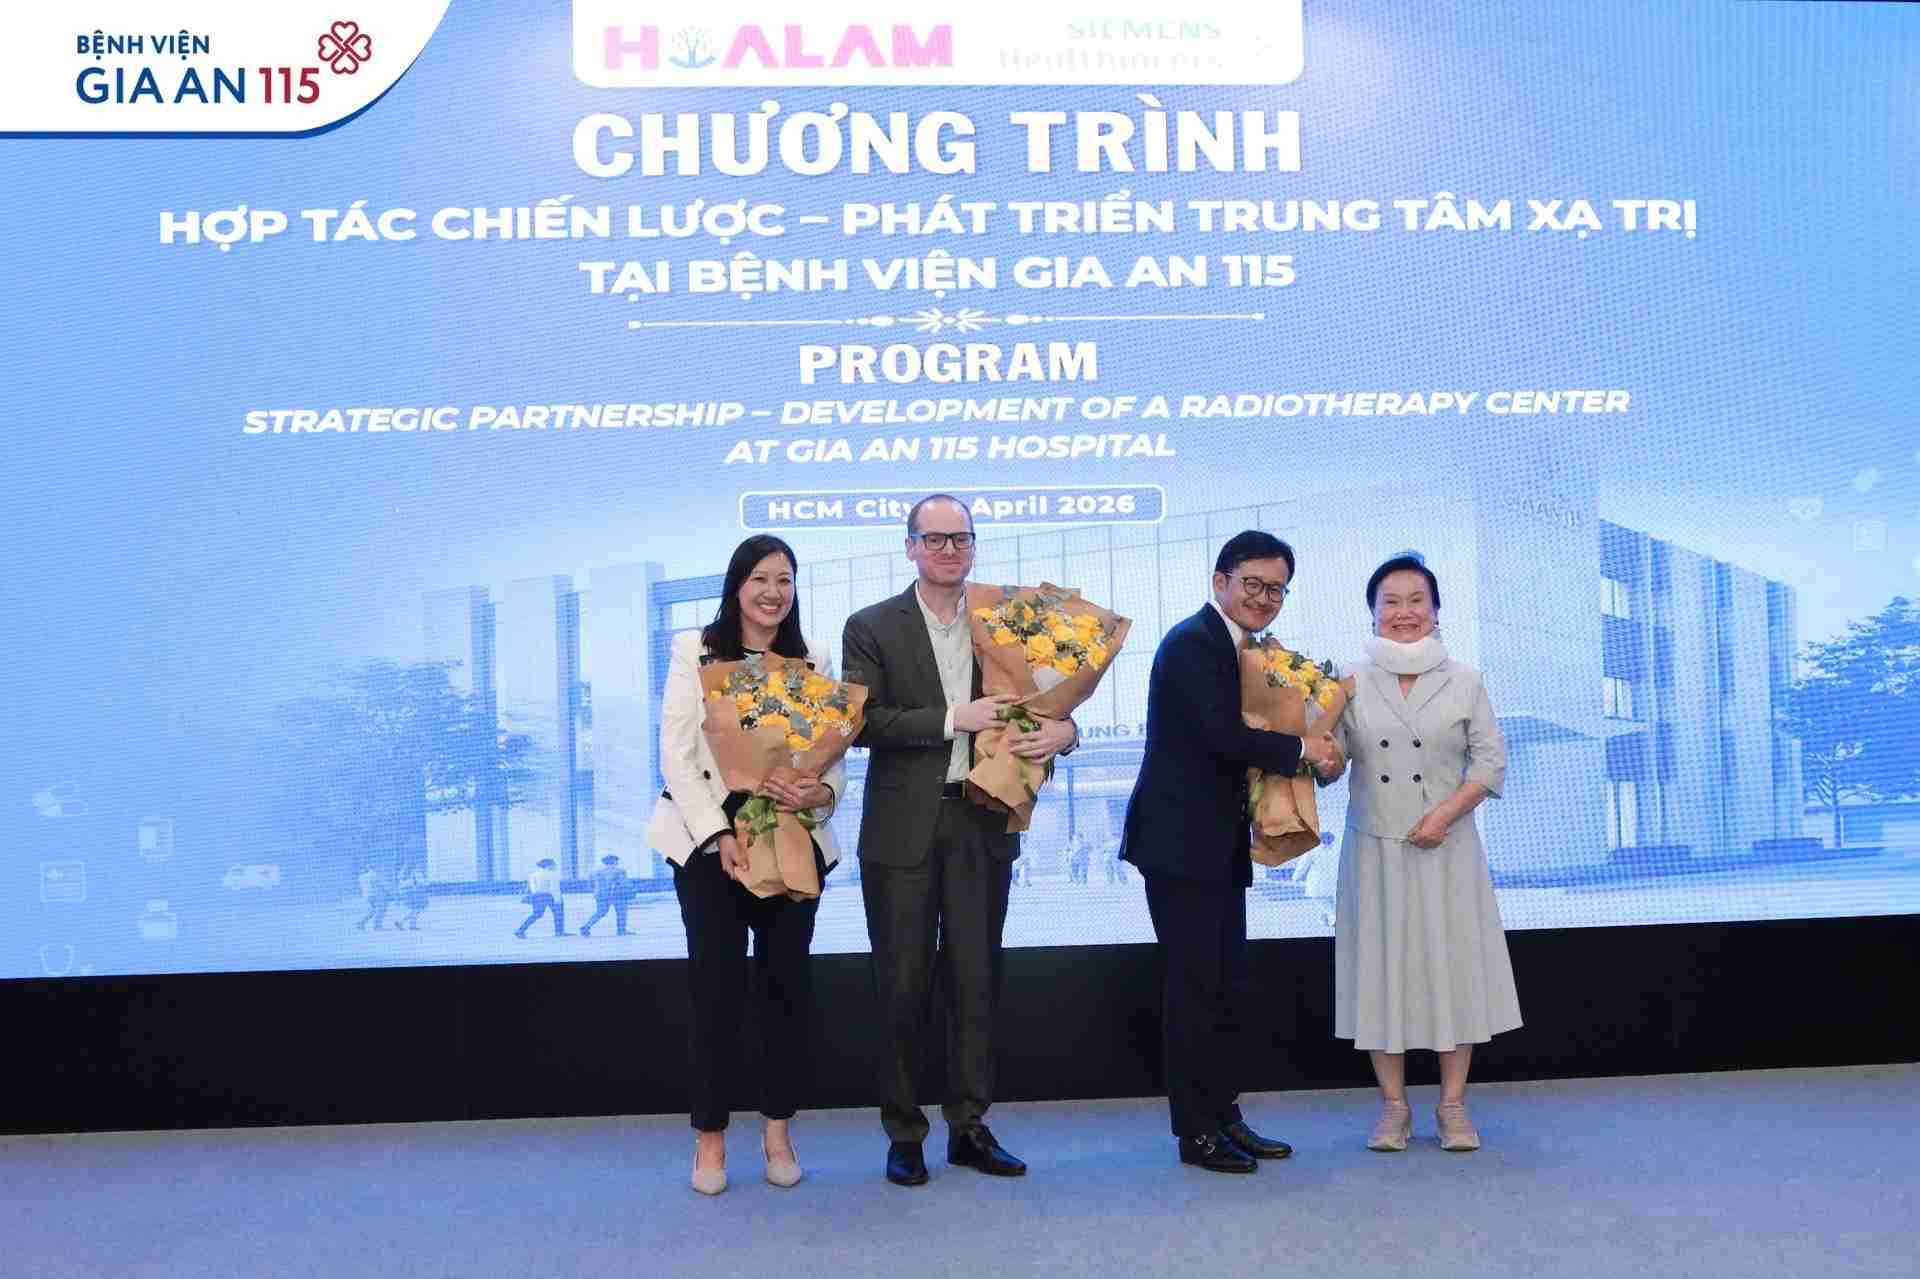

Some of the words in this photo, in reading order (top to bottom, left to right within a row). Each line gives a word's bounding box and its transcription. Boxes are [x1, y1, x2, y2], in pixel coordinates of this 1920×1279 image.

[572, 100, 976, 178] CHƯƠNG
[1010, 94, 1301, 173] TRÌNH
[160, 205, 287, 252] HỢP
[302, 200, 416, 242] TÁC
[432, 195, 610, 241] CHIẾN
[628, 198, 785, 245] LƯỢC
[843, 193, 997, 235] PHÁT
[1008, 190, 1175, 234] TRIỂN
[1188, 199, 1381, 232] TRUNG
[1393, 192, 1512, 231] TÂM
[1528, 200, 1602, 238] XẠ
[1613, 200, 1697, 238] TRỊ
[579, 261, 670, 302] TẠI
[688, 251, 848, 300] BỆNH
[862, 249, 997, 299] VIỆN
[1013, 256, 1113, 289] GIA
[1125, 256, 1206, 288] AN
[1221, 255, 1295, 287] 115
[799, 341, 1098, 385] PROGRAM
[243, 407, 460, 434] STRATEGIC
[469, 402, 744, 431] PARTNERSHIP
[780, 398, 1072, 426] DEVELOPMENT
[1081, 396, 1138, 420] OF
[1142, 397, 1170, 419] A
[1180, 392, 1474, 419] RADIOTHERAPY
[1486, 390, 1630, 415] CENTER
[724, 440, 780, 464] AT
[786, 439, 853, 463] GIA
[860, 438, 920, 462] AN
[929, 437, 979, 461] 115
[987, 432, 1176, 460] HOSPITAL
[767, 499, 844, 521] HCM
[970, 495, 1049, 519] April
[1057, 494, 1136, 515] 2026
